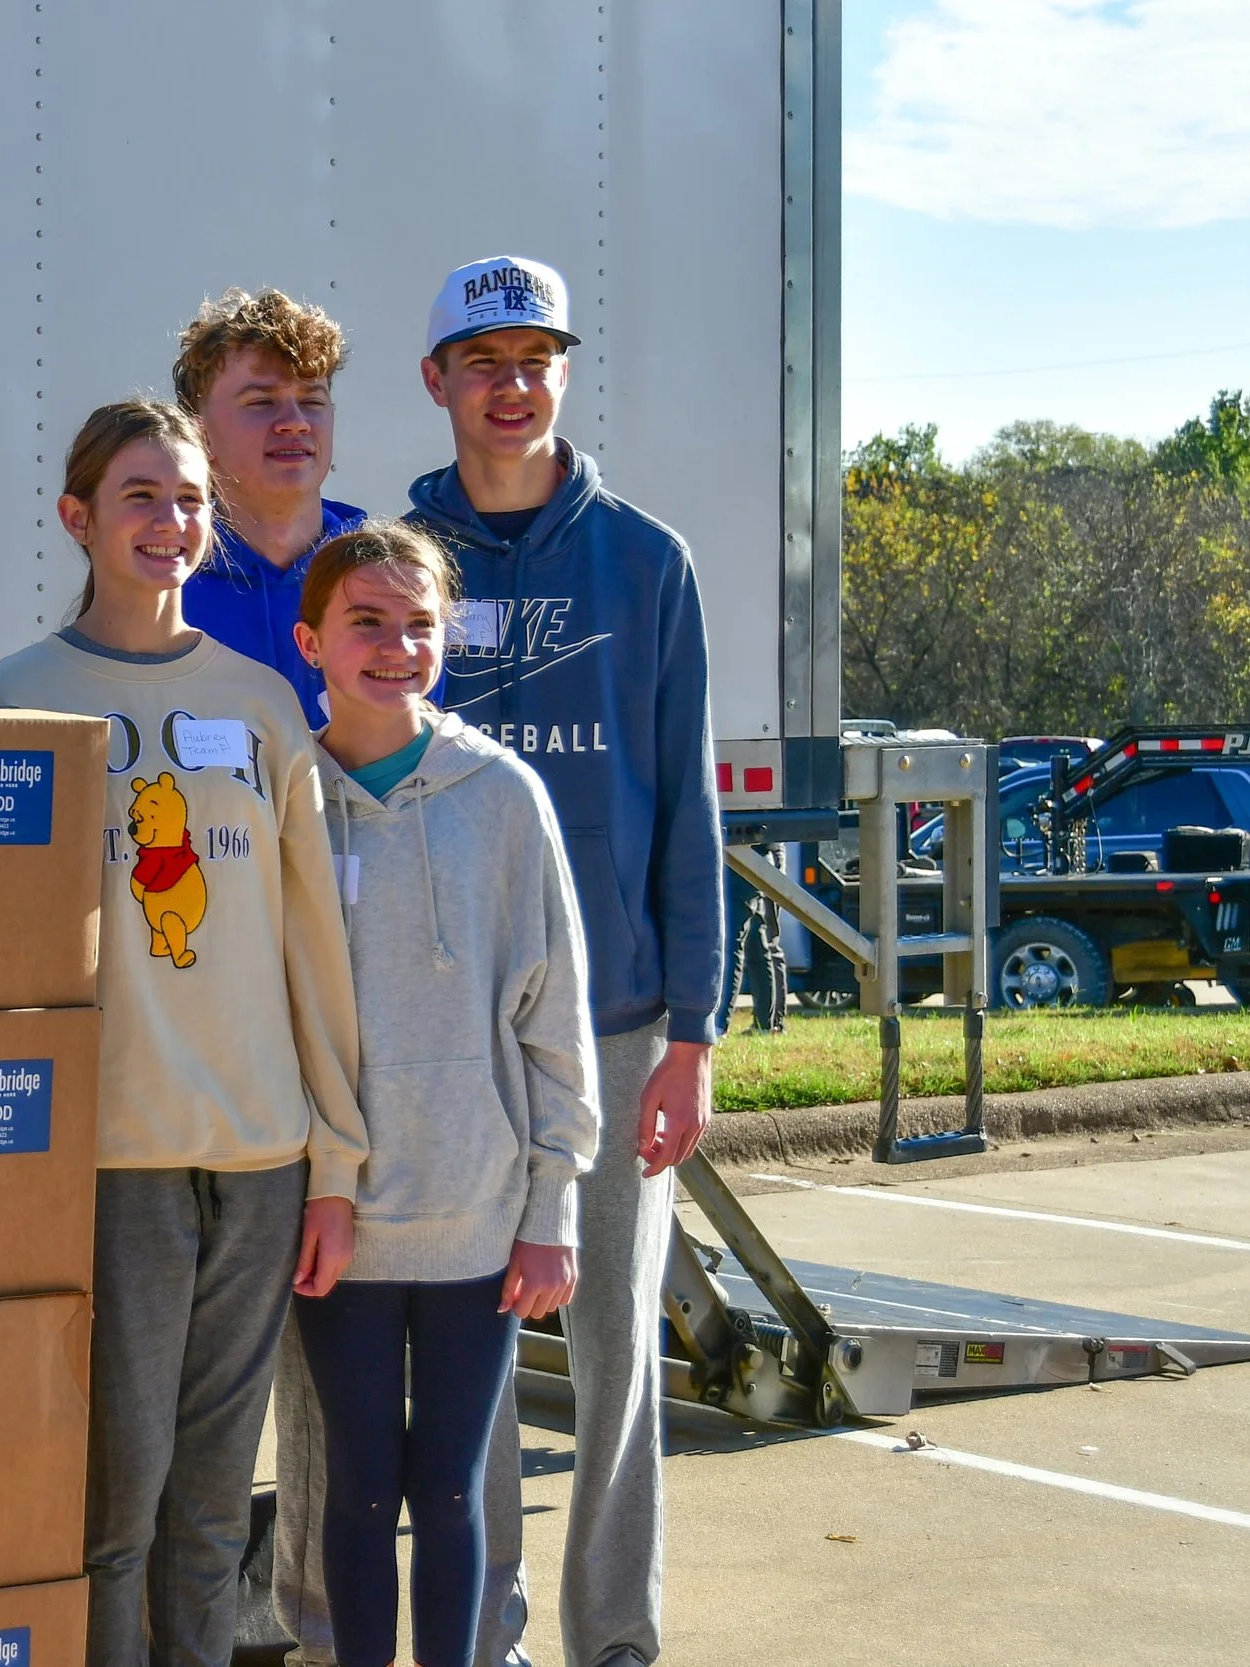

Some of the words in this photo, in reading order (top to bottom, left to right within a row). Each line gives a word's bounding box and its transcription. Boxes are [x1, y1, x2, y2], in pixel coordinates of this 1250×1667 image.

[464, 267, 555, 308] RANGERS
[182, 729, 231, 750] Aubrey
[206, 825, 250, 860] 1966
